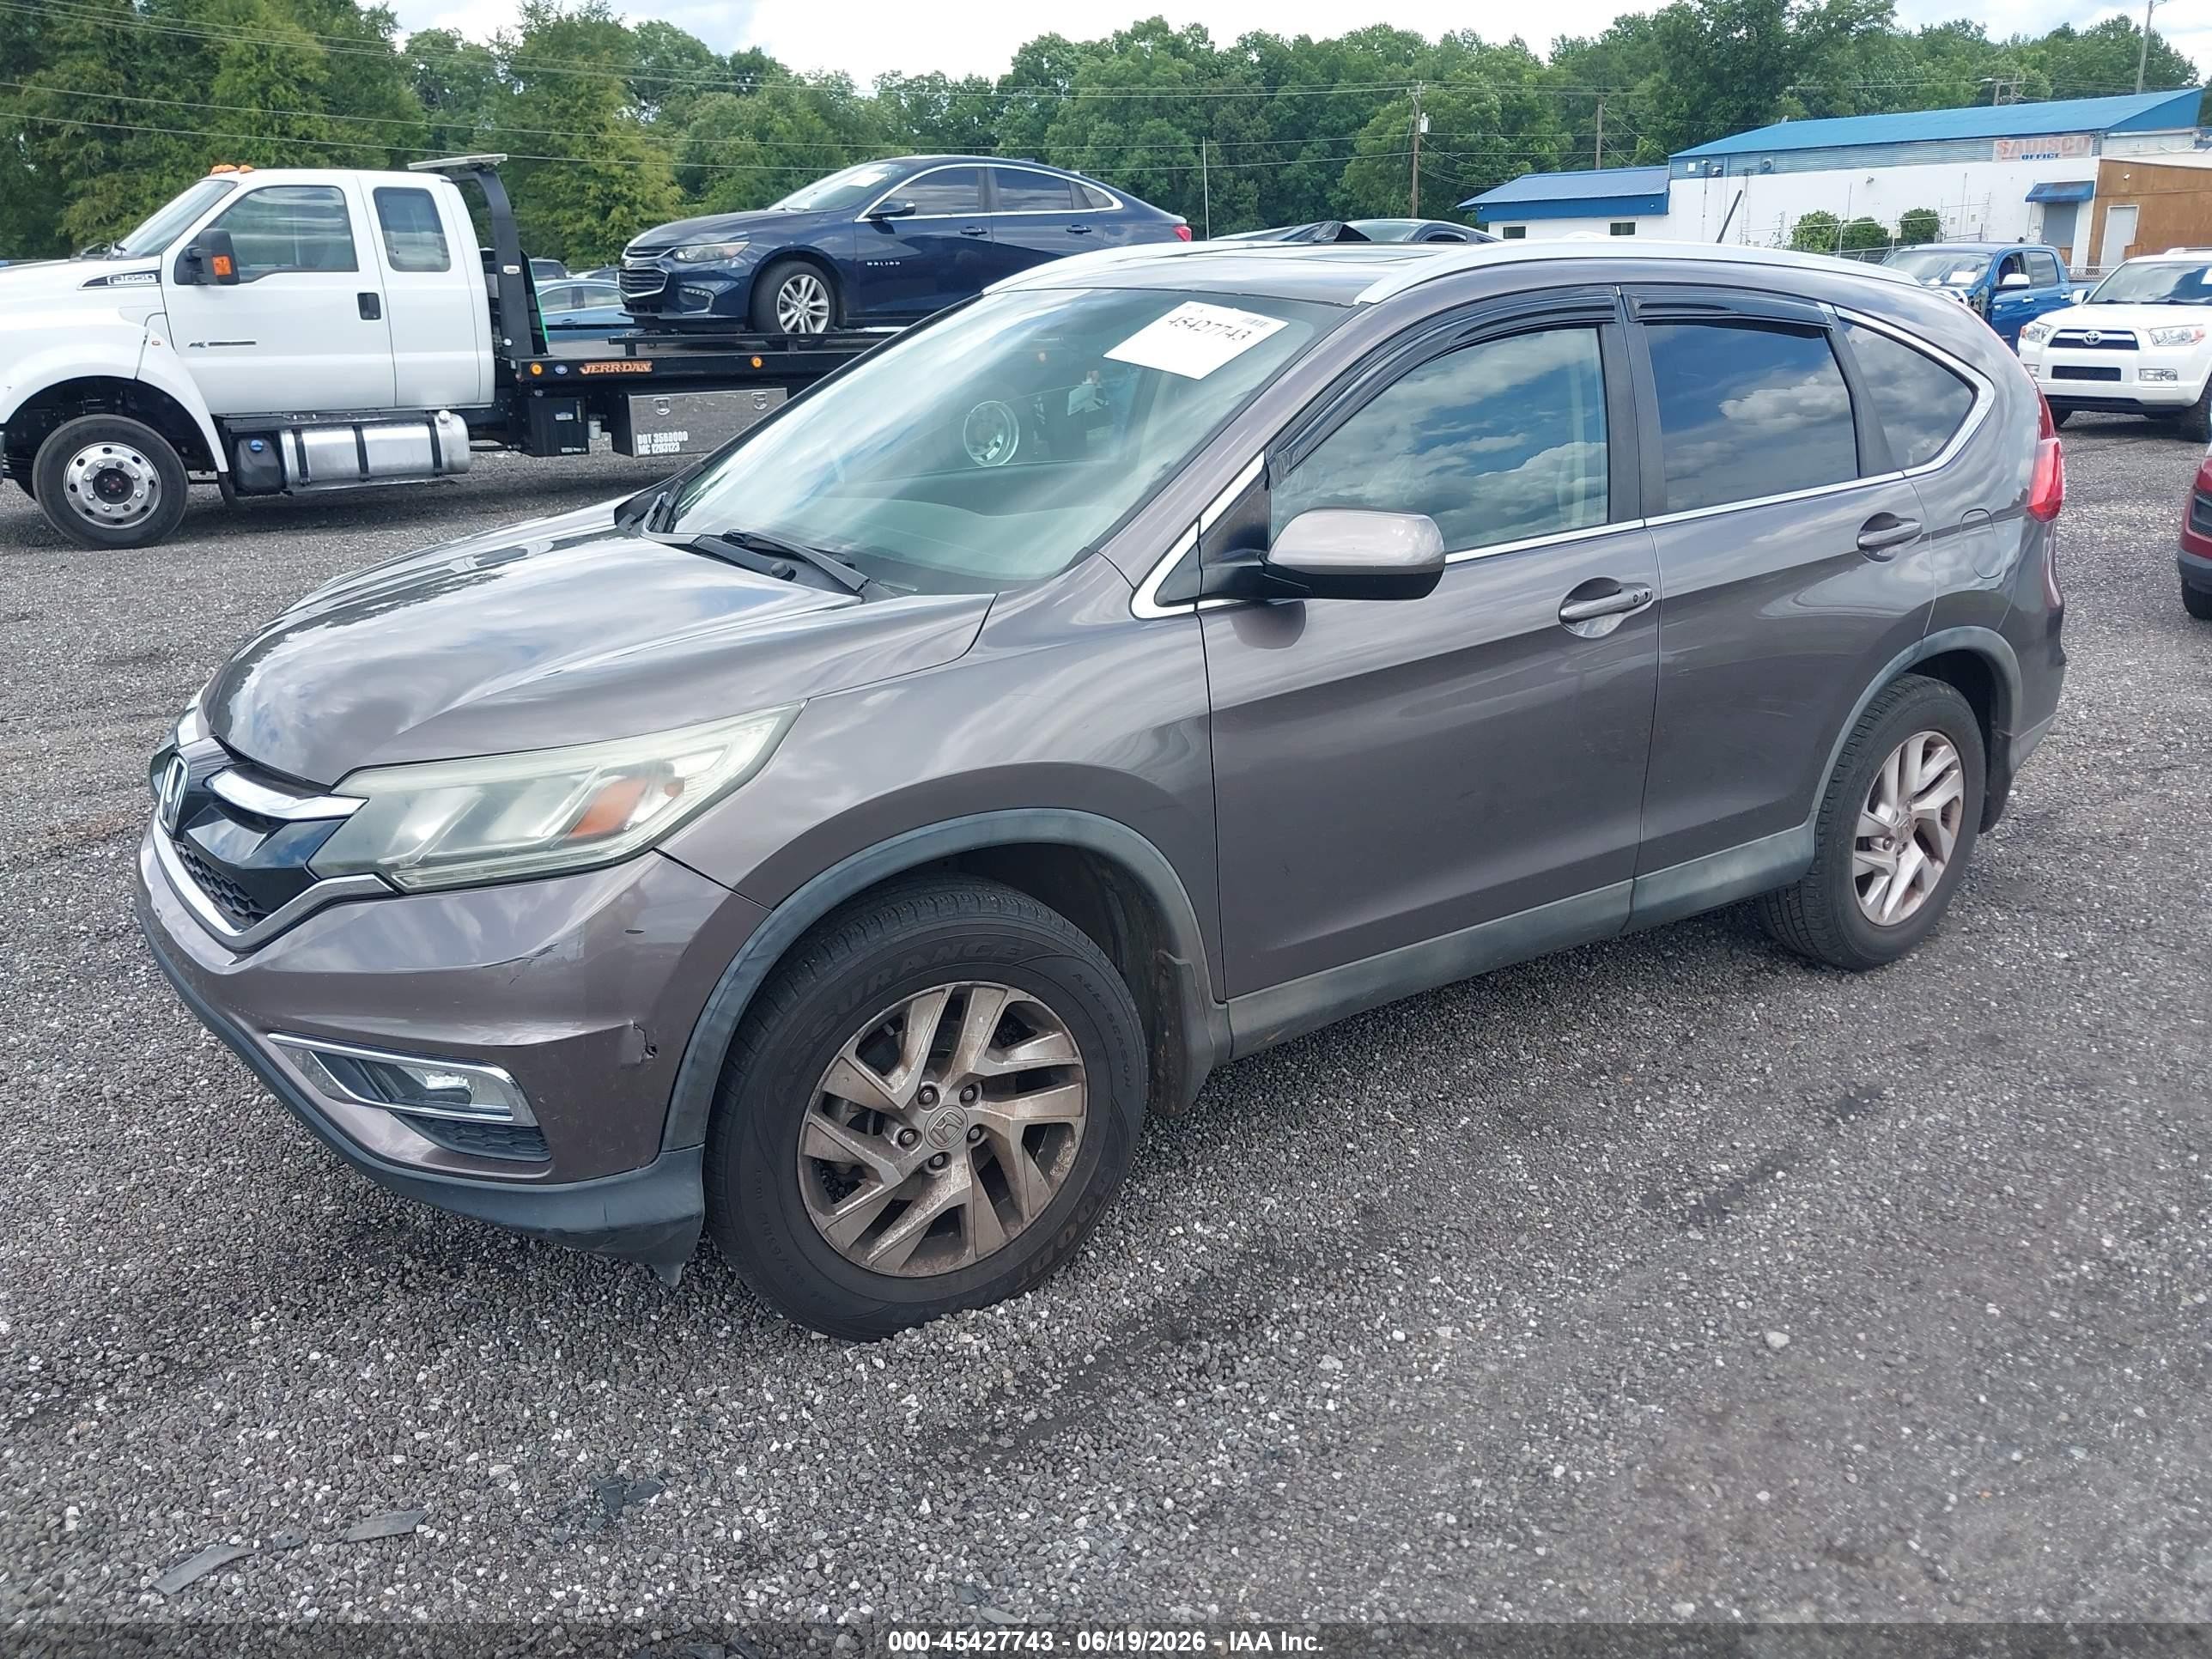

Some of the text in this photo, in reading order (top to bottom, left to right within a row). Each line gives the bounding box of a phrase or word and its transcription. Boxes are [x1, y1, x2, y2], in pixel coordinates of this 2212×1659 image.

[1997, 137, 2091, 154] SADISCO
[2021, 152, 2061, 161] OFFICE
[1168, 316, 1252, 340] 45427743
[637, 434, 652, 444] DOT
[638, 445, 651, 454] MC
